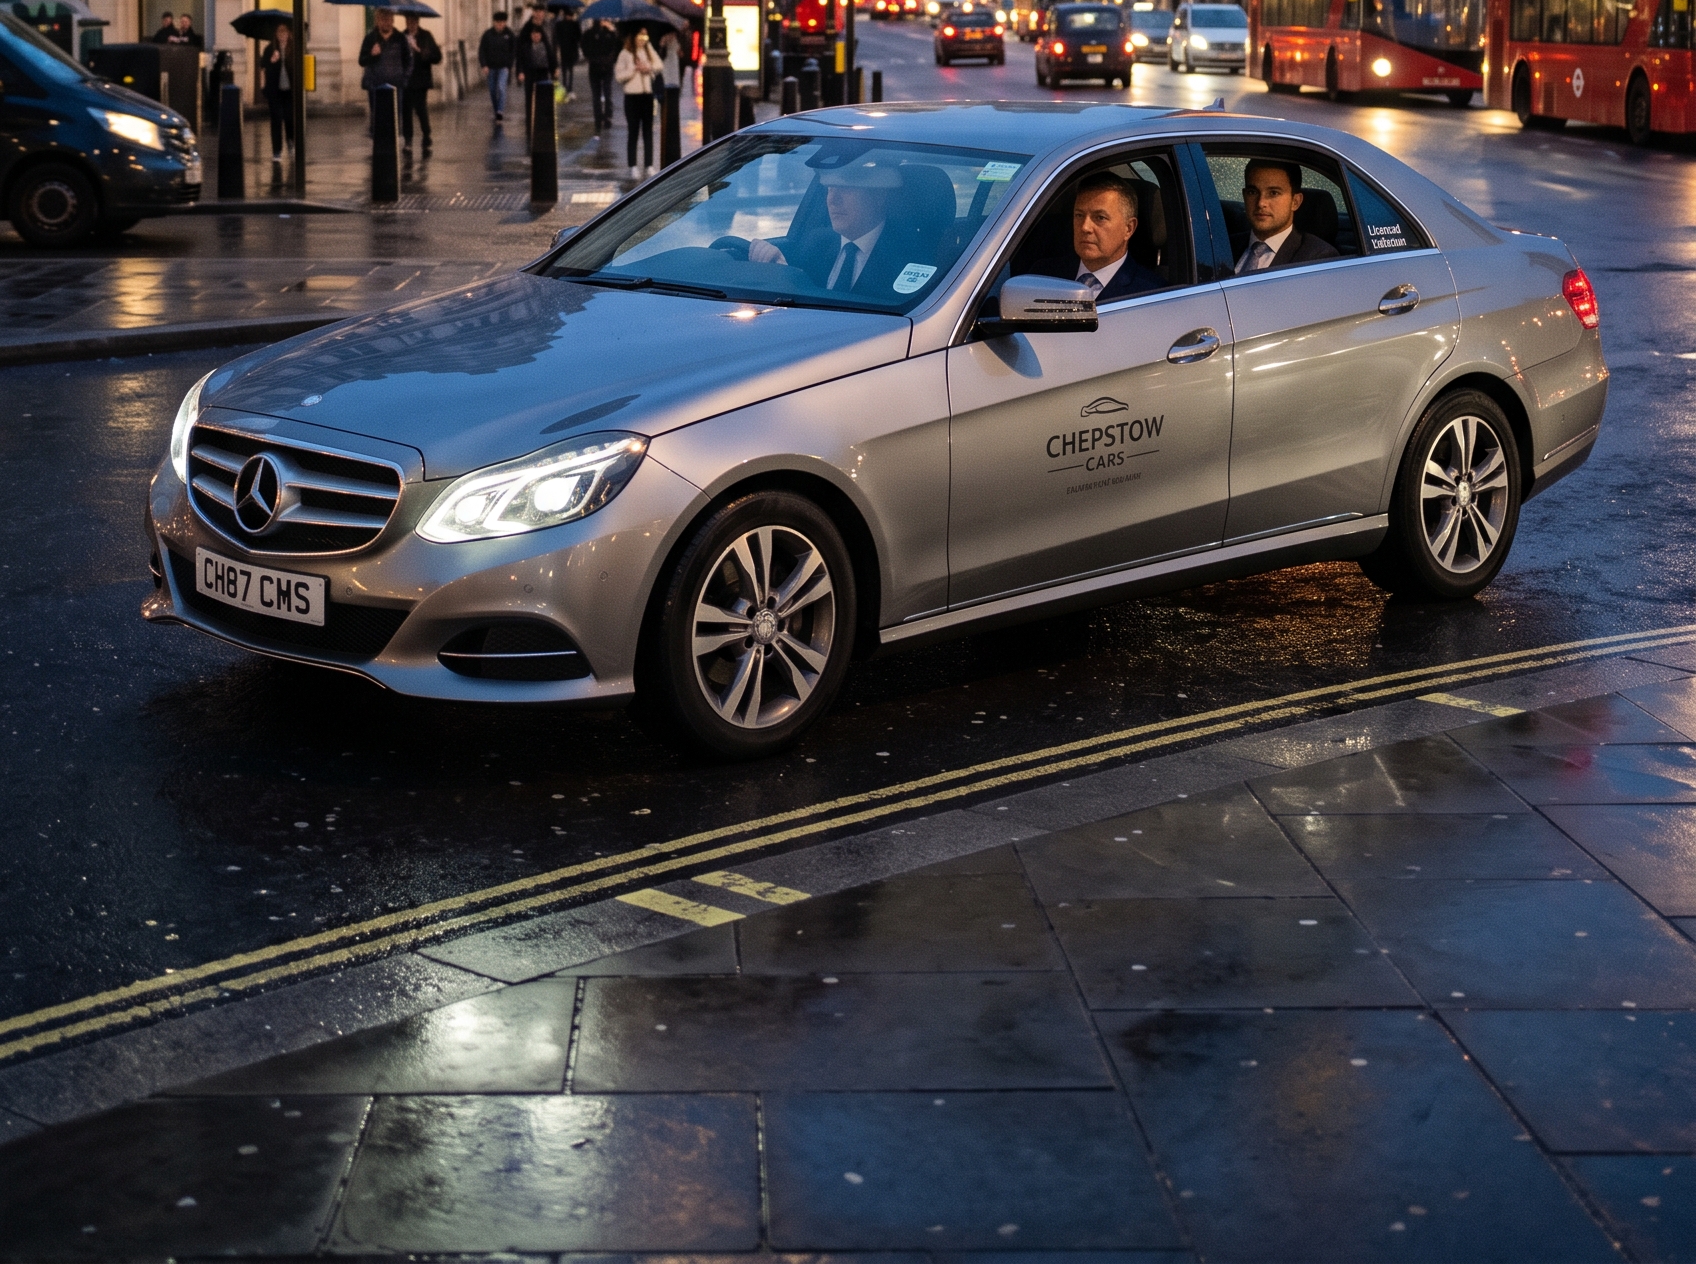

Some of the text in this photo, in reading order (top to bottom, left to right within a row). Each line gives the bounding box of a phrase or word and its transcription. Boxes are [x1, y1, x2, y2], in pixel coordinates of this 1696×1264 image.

[1046, 414, 1165, 458] CHEPSTOW
[1085, 451, 1125, 471] CARS
[204, 557, 310, 615] CH87 CMS
